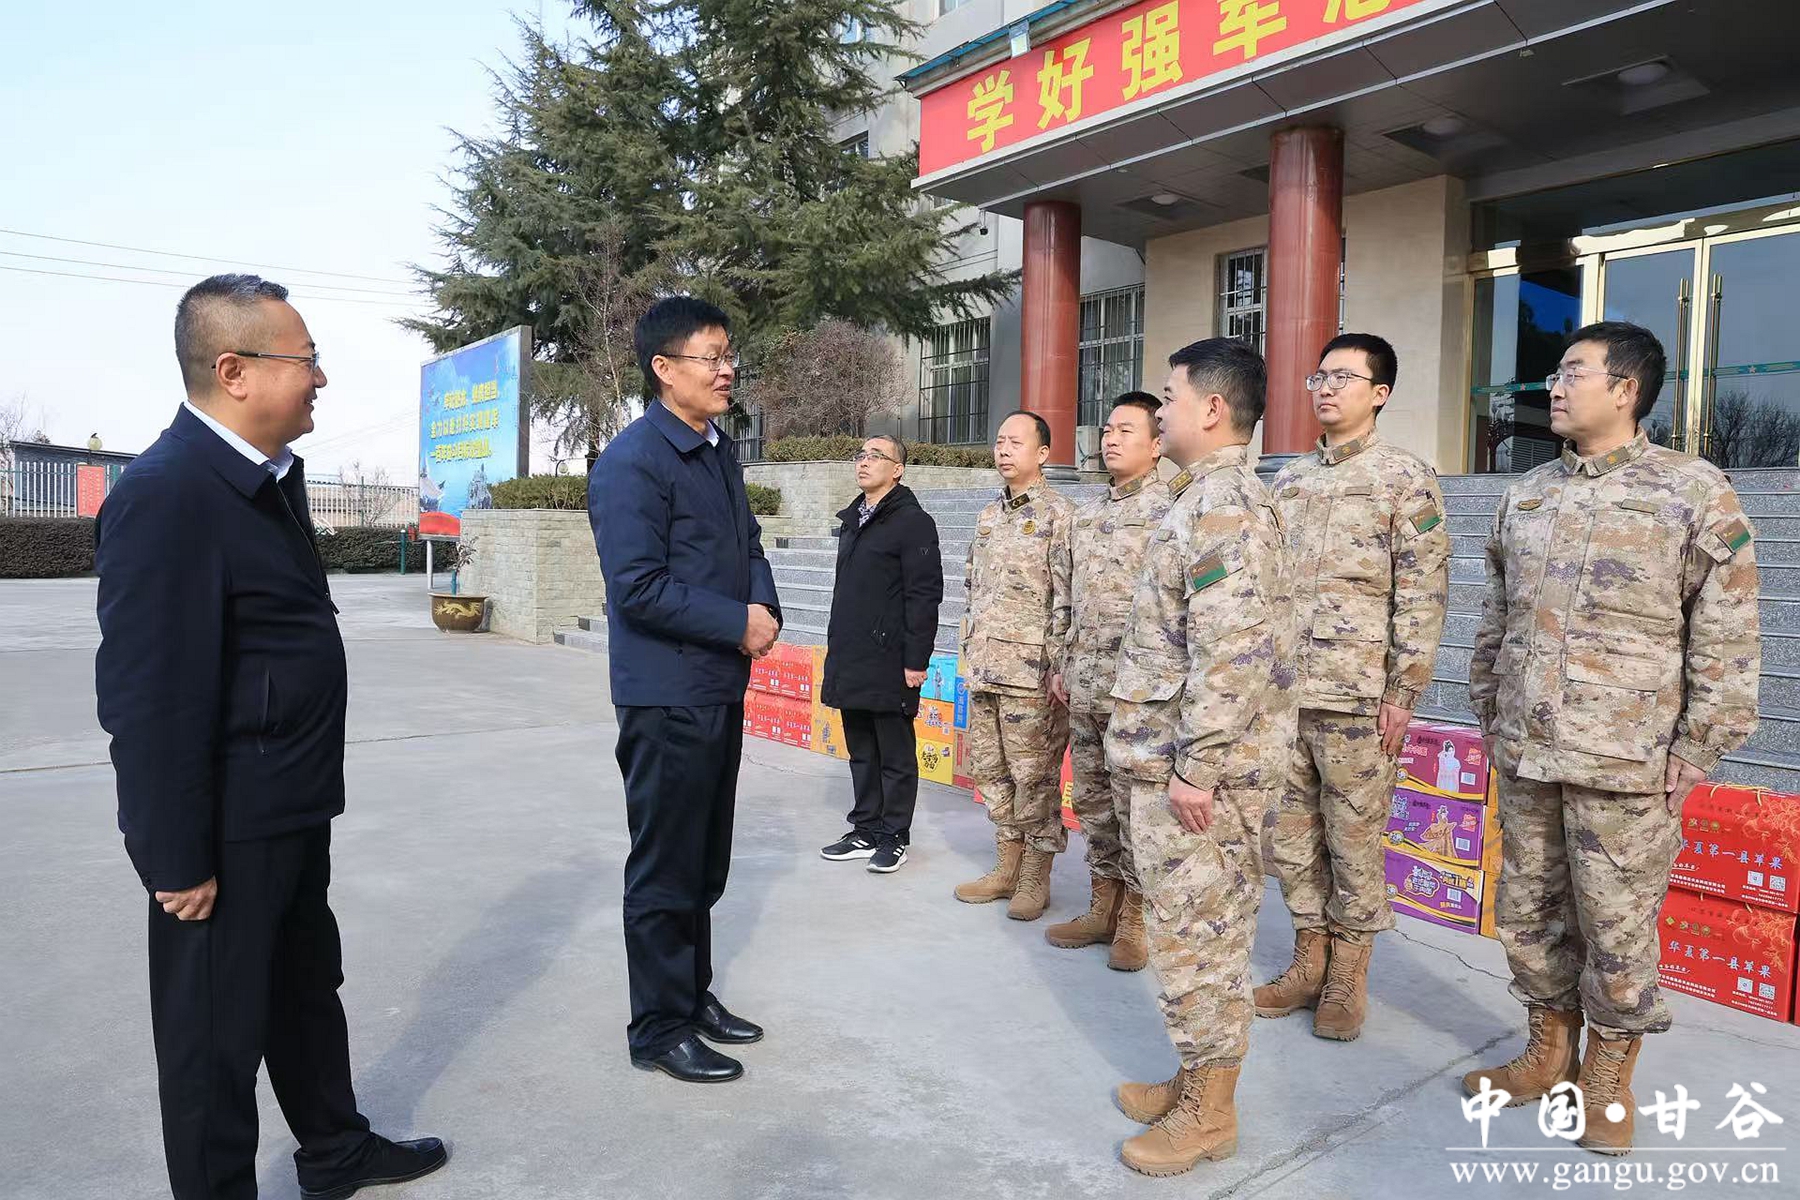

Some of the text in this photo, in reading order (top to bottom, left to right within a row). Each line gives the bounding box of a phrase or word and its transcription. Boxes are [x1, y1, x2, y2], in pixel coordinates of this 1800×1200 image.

[1668, 940, 1771, 979] 华夏第一县苹果
